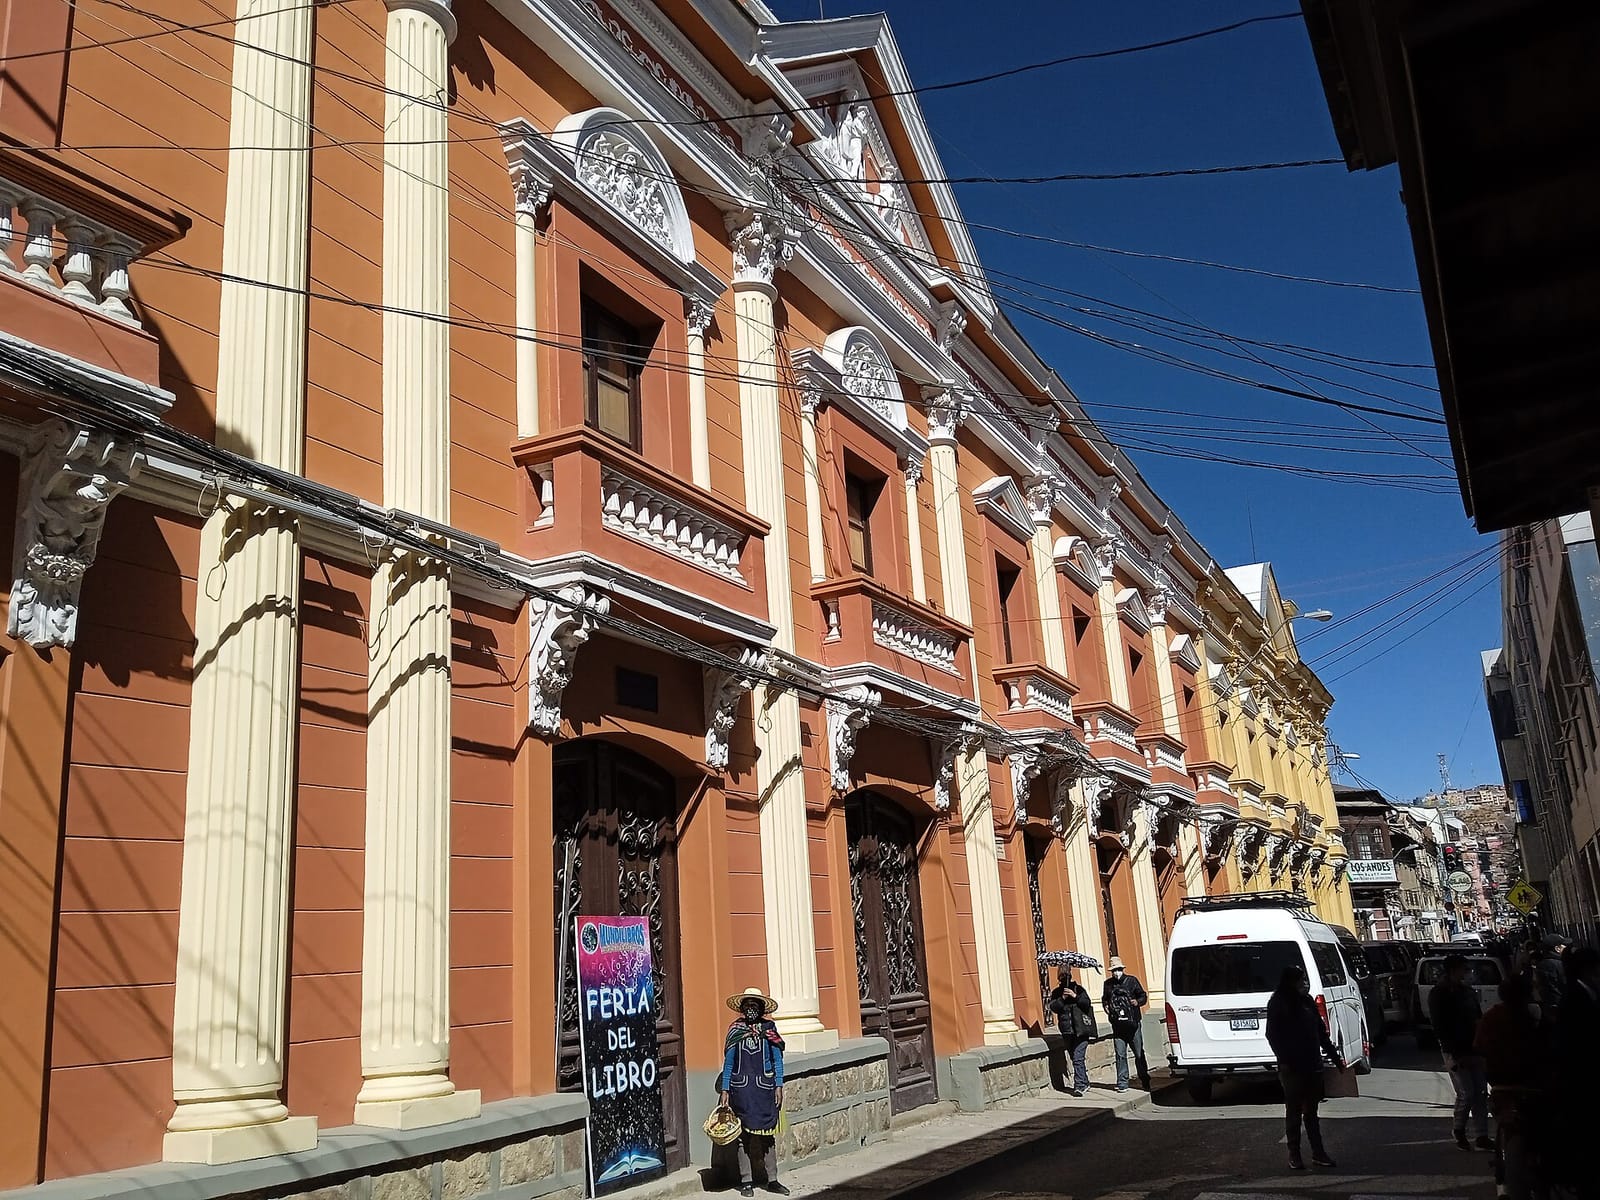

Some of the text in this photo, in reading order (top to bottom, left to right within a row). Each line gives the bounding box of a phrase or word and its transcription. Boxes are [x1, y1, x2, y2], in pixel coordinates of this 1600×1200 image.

[1350, 862, 1391, 873] LOS ANDES
[599, 923, 645, 947] MUNDILIBROS
[586, 986, 650, 1021] FERIA
[607, 1026, 636, 1051] DEL
[591, 1058, 656, 1099] LIBRO
